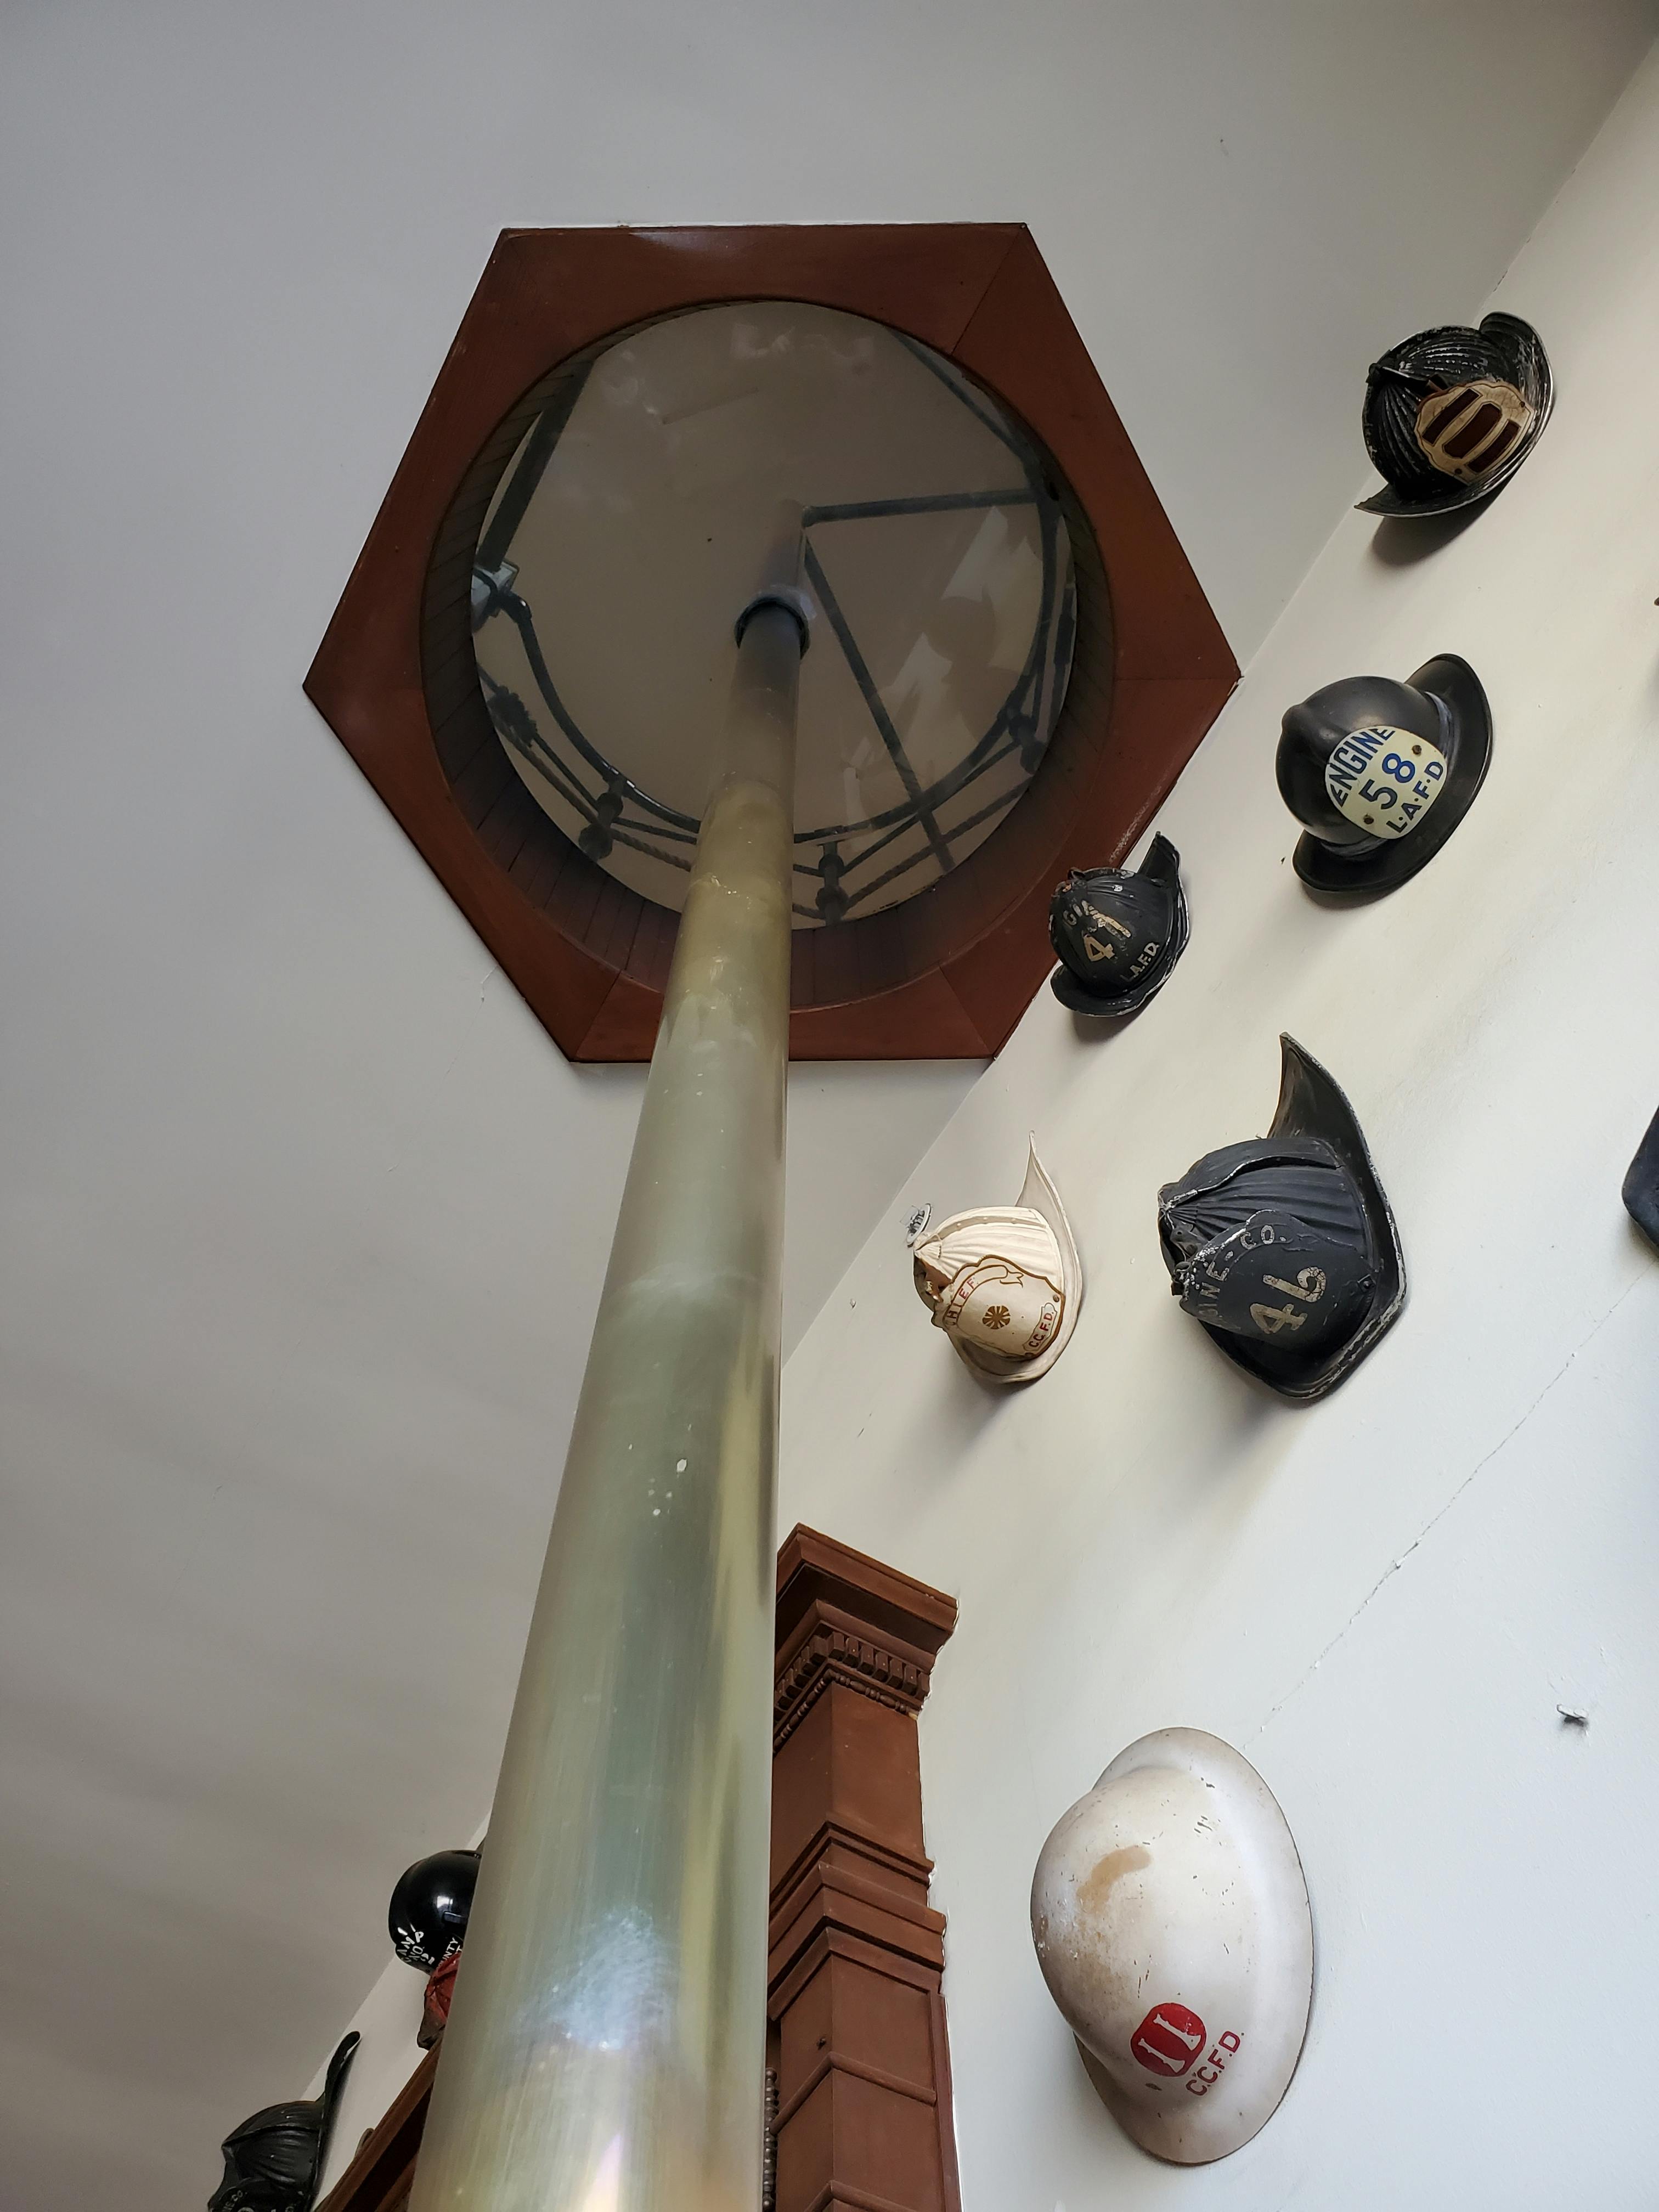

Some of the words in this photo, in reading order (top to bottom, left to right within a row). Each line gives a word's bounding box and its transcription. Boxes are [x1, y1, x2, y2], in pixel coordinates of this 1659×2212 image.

[1328, 727, 1396, 808] ENGINE
[1358, 752, 1415, 810] 58
[1249, 1266, 1327, 1334] 46
